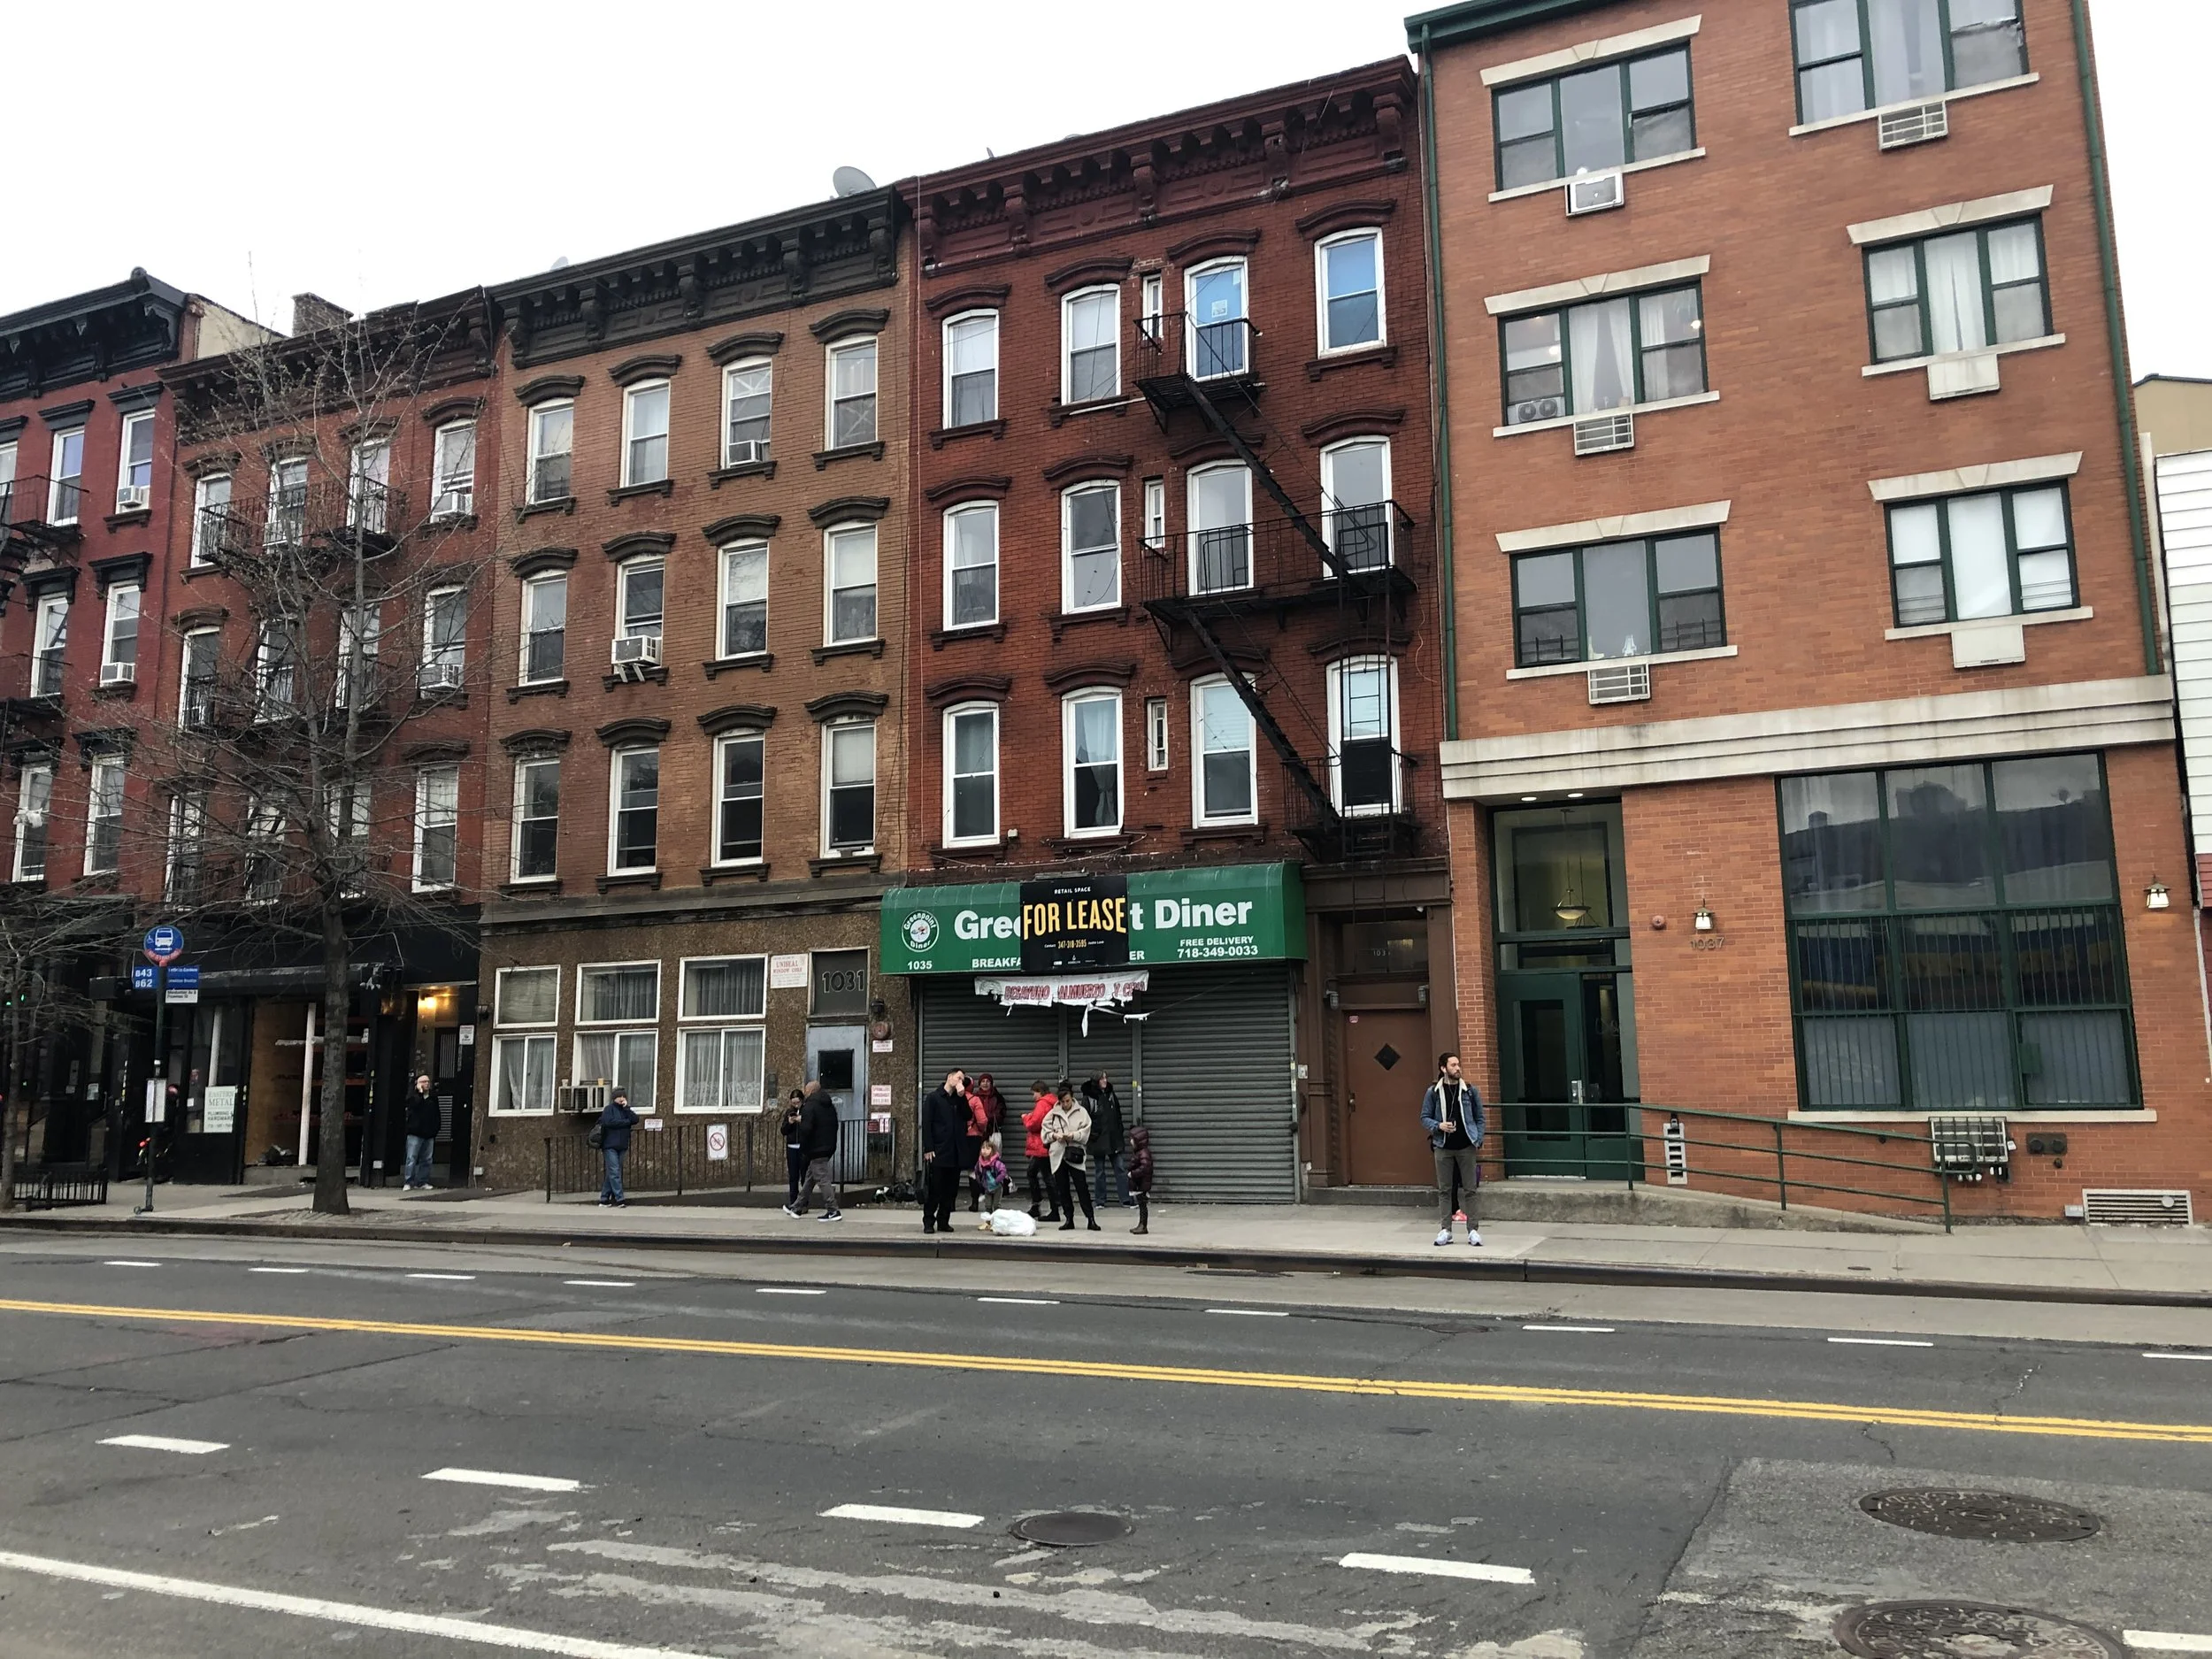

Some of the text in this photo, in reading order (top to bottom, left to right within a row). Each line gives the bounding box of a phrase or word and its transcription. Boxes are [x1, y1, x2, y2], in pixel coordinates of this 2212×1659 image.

[1023, 897, 1126, 941] FOR LEASE
[1155, 897, 1253, 929] Diner
[903, 912, 937, 930] Greenpoint
[910, 940, 931, 949] Diner
[1179, 935, 1254, 947] FREE DELIVERY
[1691, 937, 1724, 949] 1037
[1177, 945, 1258, 958] 718-349-0033
[907, 960, 933, 970] 1035
[134, 968, 152, 978] B43
[134, 979, 153, 988] B62
[822, 970, 864, 994] 1031
[1004, 985, 1050, 1000] DESAYUNO
[1113, 982, 1120, 997] Y
